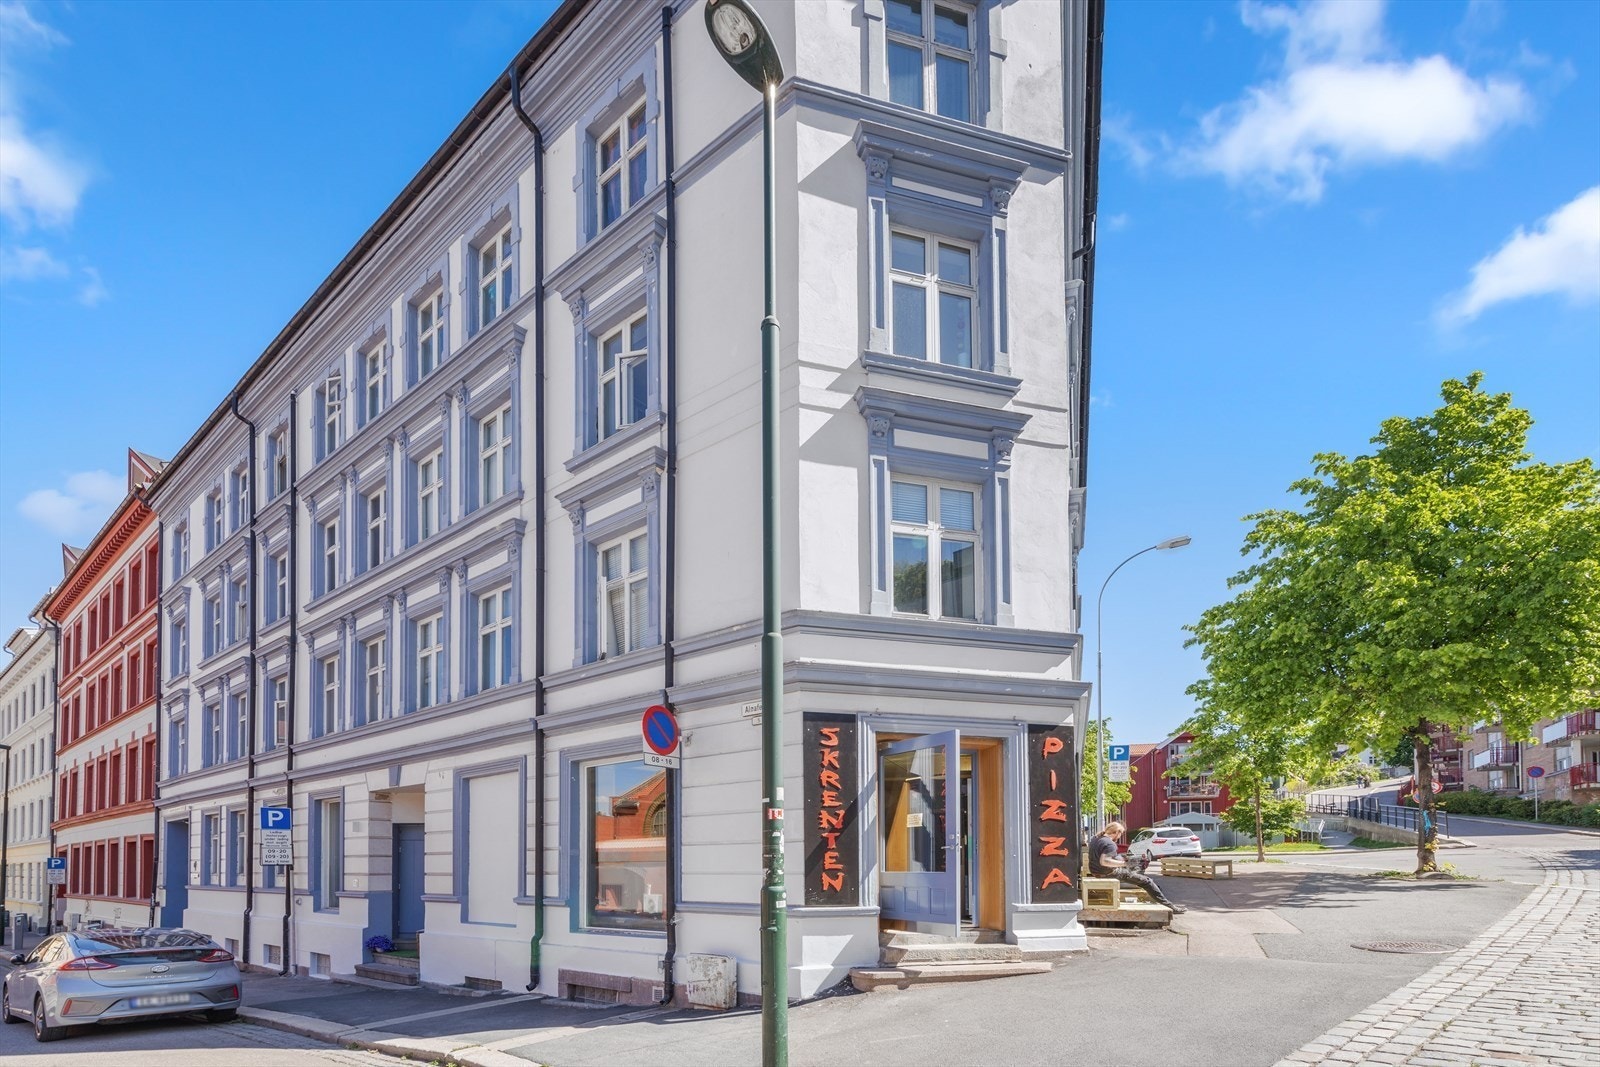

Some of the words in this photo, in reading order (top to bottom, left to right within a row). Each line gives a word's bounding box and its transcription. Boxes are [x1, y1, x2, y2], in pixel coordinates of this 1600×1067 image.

[744, 704, 763, 714] Alnafe
[1113, 746, 1125, 760] P
[819, 727, 845, 892] SKRENTEN
[1039, 736, 1074, 890] PIZZA
[268, 810, 284, 827] P
[51, 858, 62, 868] P
